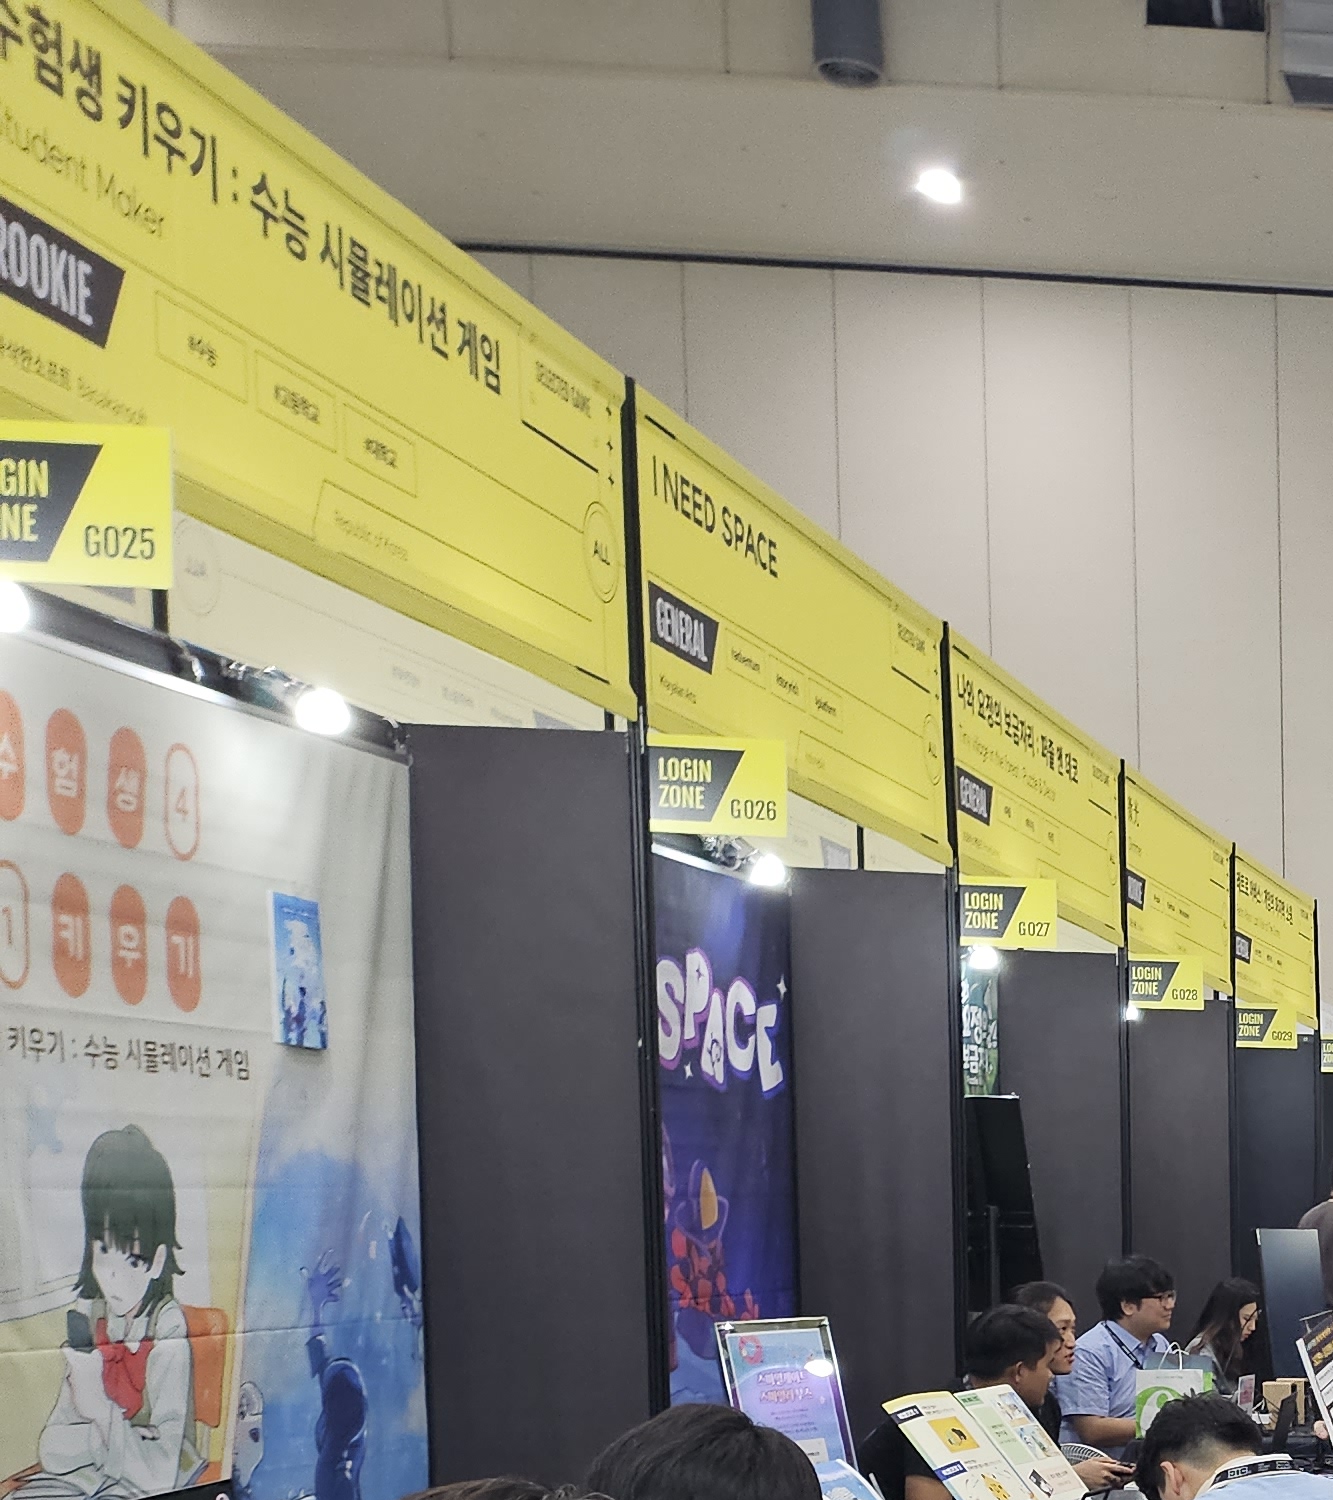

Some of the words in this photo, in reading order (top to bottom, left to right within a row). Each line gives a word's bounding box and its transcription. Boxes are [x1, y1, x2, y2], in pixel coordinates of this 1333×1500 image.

[117, 74, 219, 205] 키우기
[250, 172, 310, 262] 수능
[320, 218, 449, 361] 시뮬레이션
[457, 319, 502, 395] 게임
[651, 454, 659, 497] I
[663, 462, 717, 534] NEED
[721, 504, 779, 579] SPACE
[84, 525, 156, 560] G025
[592, 540, 611, 566] ALL
[654, 596, 709, 663] GENERAL
[657, 756, 713, 784] LOGIN
[657, 785, 706, 810] ZONE
[730, 798, 778, 822] G026
[963, 892, 1004, 911] LOGIN
[963, 911, 999, 930] ZONE
[1018, 921, 1051, 938] G027
[1131, 966, 1162, 981] LOGIN
[1131, 981, 1159, 995] ZONE
[1171, 988, 1199, 1001] G028
[656, 948, 784, 1096] SPACE
[1238, 1012, 1264, 1025] LOGIN
[1238, 1025, 1261, 1037] ZONE
[1271, 1031, 1293, 1041] G029
[7, 1026, 65, 1062] 키우기
[83, 1034, 120, 1070] 수능
[126, 1039, 212, 1077] 시뮬레이션
[217, 1048, 250, 1081] 게임
